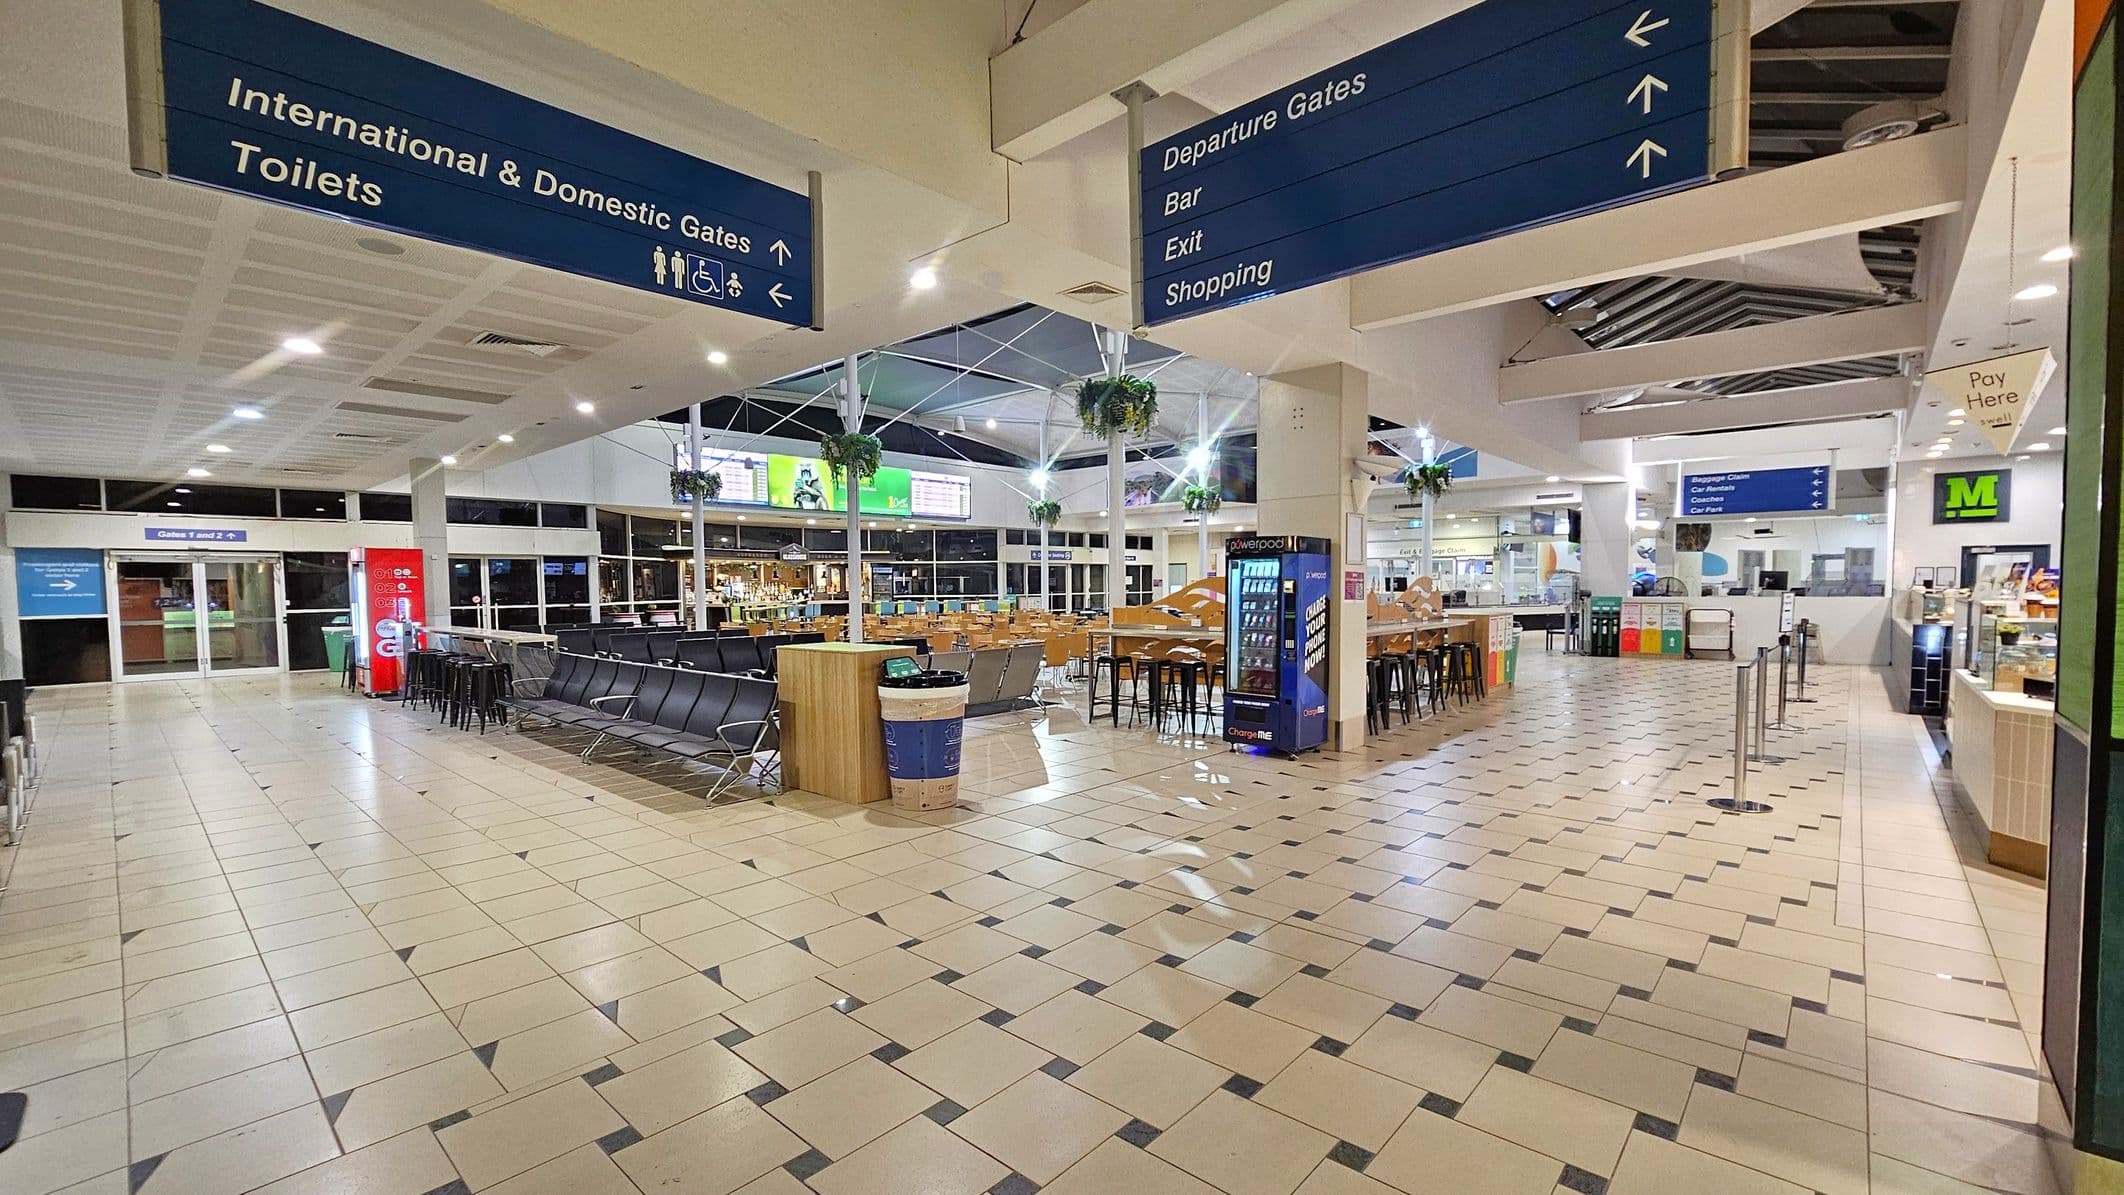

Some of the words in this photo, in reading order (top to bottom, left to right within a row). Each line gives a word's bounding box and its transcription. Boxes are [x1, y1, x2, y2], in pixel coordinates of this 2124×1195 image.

[1163, 105, 1278, 173] Departure
[1286, 71, 1367, 121] Gates
[228, 77, 487, 178] International
[498, 159, 522, 187] &
[533, 170, 671, 230] Domestic
[679, 213, 752, 254] Gates
[230, 140, 383, 207] Toilets
[1164, 184, 1203, 216] Bar
[1165, 229, 1204, 262] Exit
[1165, 257, 1273, 307] Shopping
[1969, 371, 2006, 389] Pay
[1966, 392, 2019, 410] Here
[1980, 413, 2012, 425] swell
[1691, 475, 1726, 483] Baggage
[1727, 473, 1750, 481] Claim
[1706, 485, 1735, 493] Rentals
[1946, 475, 1999, 509] M
[1691, 496, 1724, 504] Coaches
[157, 530, 187, 539] Gates
[188, 531, 194, 539] 1
[196, 531, 214, 539] and
[215, 531, 223, 539] 2
[1230, 538, 1285, 551] powerpod
[1400, 548, 1412, 556] Exit
[1419, 547, 1446, 556] Bgage
[1305, 570, 1327, 580] powerpod
[374, 583, 396, 594] 02
[1305, 594, 1326, 622] CHARGE
[1305, 612, 1326, 638] YOUR
[1304, 627, 1326, 657] PHONE
[1304, 644, 1326, 674] NOW!
[1303, 705, 1325, 717] ChargeME
[1228, 727, 1273, 740] ChargeME
